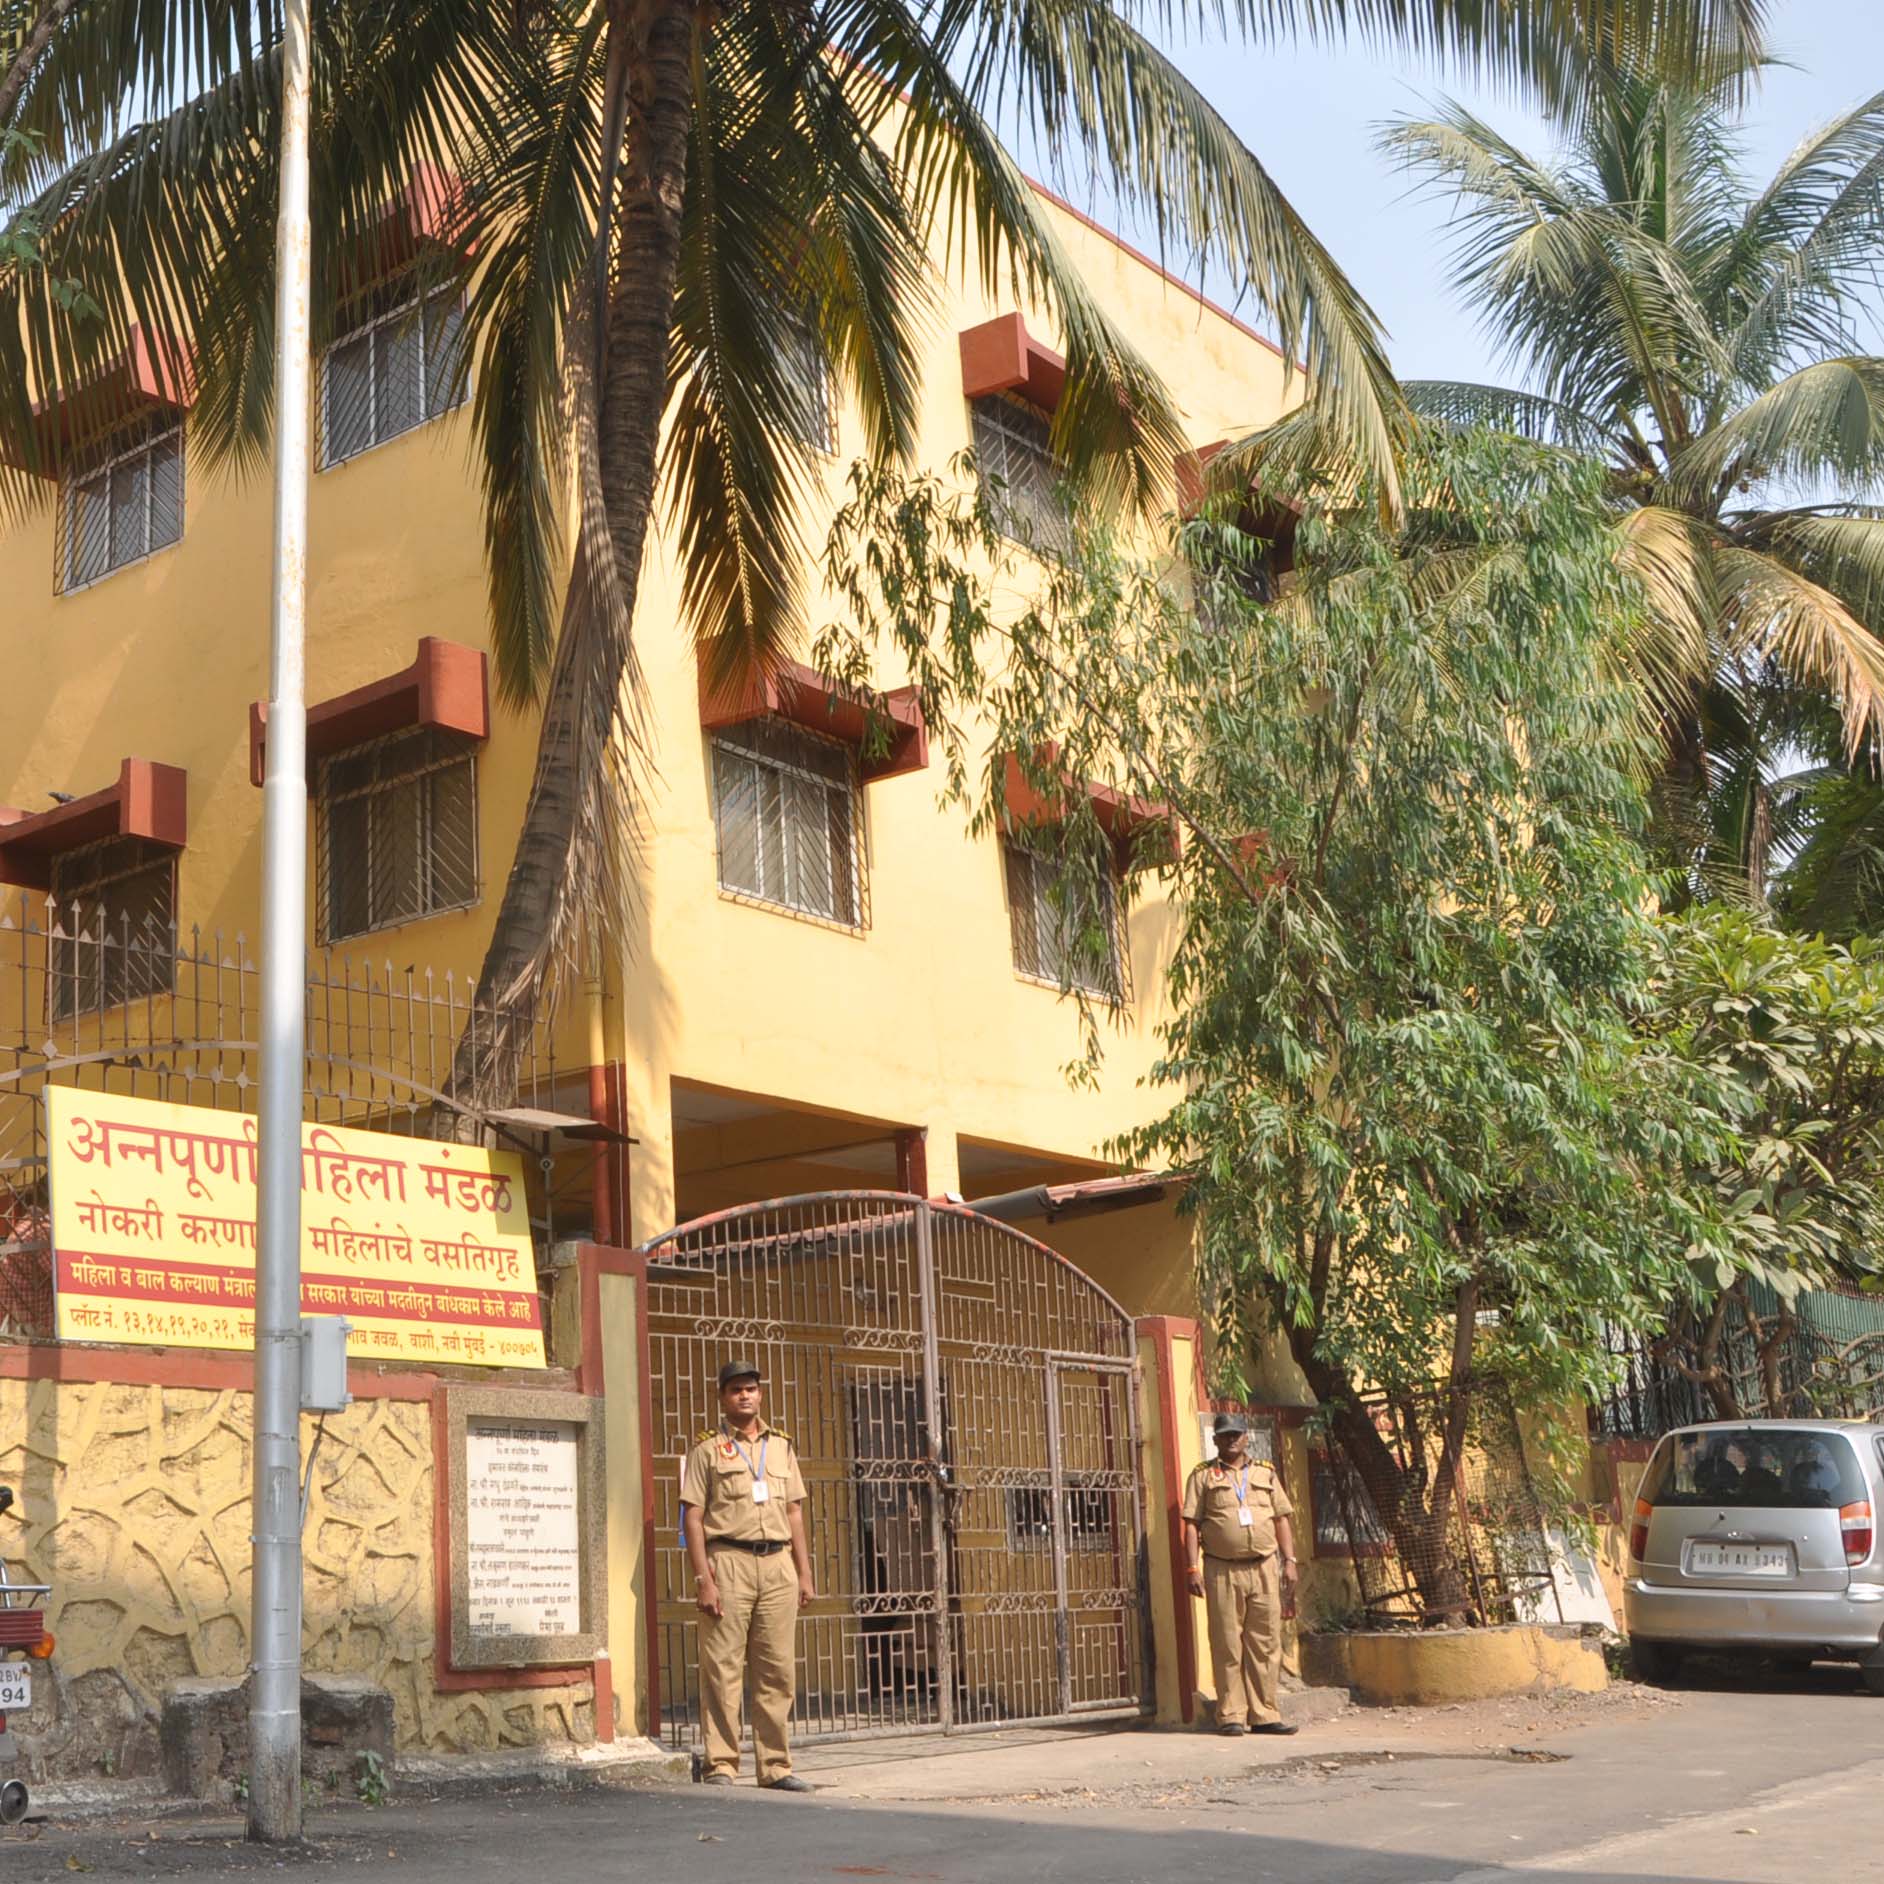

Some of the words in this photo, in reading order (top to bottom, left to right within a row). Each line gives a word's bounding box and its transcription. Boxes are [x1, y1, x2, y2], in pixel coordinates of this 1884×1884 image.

[67, 1117, 257, 1202] अन्नपूर्णा
[418, 1148, 513, 1214] मंडळ
[75, 1189, 164, 1241] नोकरी
[177, 1213, 257, 1249] करणा
[308, 1216, 413, 1264] महिलांचे
[420, 1231, 520, 1282] वसतिगृह
[69, 1303, 100, 1328] प्लॉट
[70, 1255, 116, 1288] महिला
[119, 1267, 132, 1288] व
[135, 1268, 165, 1291] बाल
[168, 1270, 220, 1296] कल्याण
[222, 1269, 257, 1299] मंत्राल
[306, 1283, 348, 1306] सरकार
[349, 1281, 385, 1308] यांच्या
[436, 1288, 481, 1316] बांधकाम
[483, 1291, 506, 1318] केले
[508, 1294, 532, 1321] आहे
